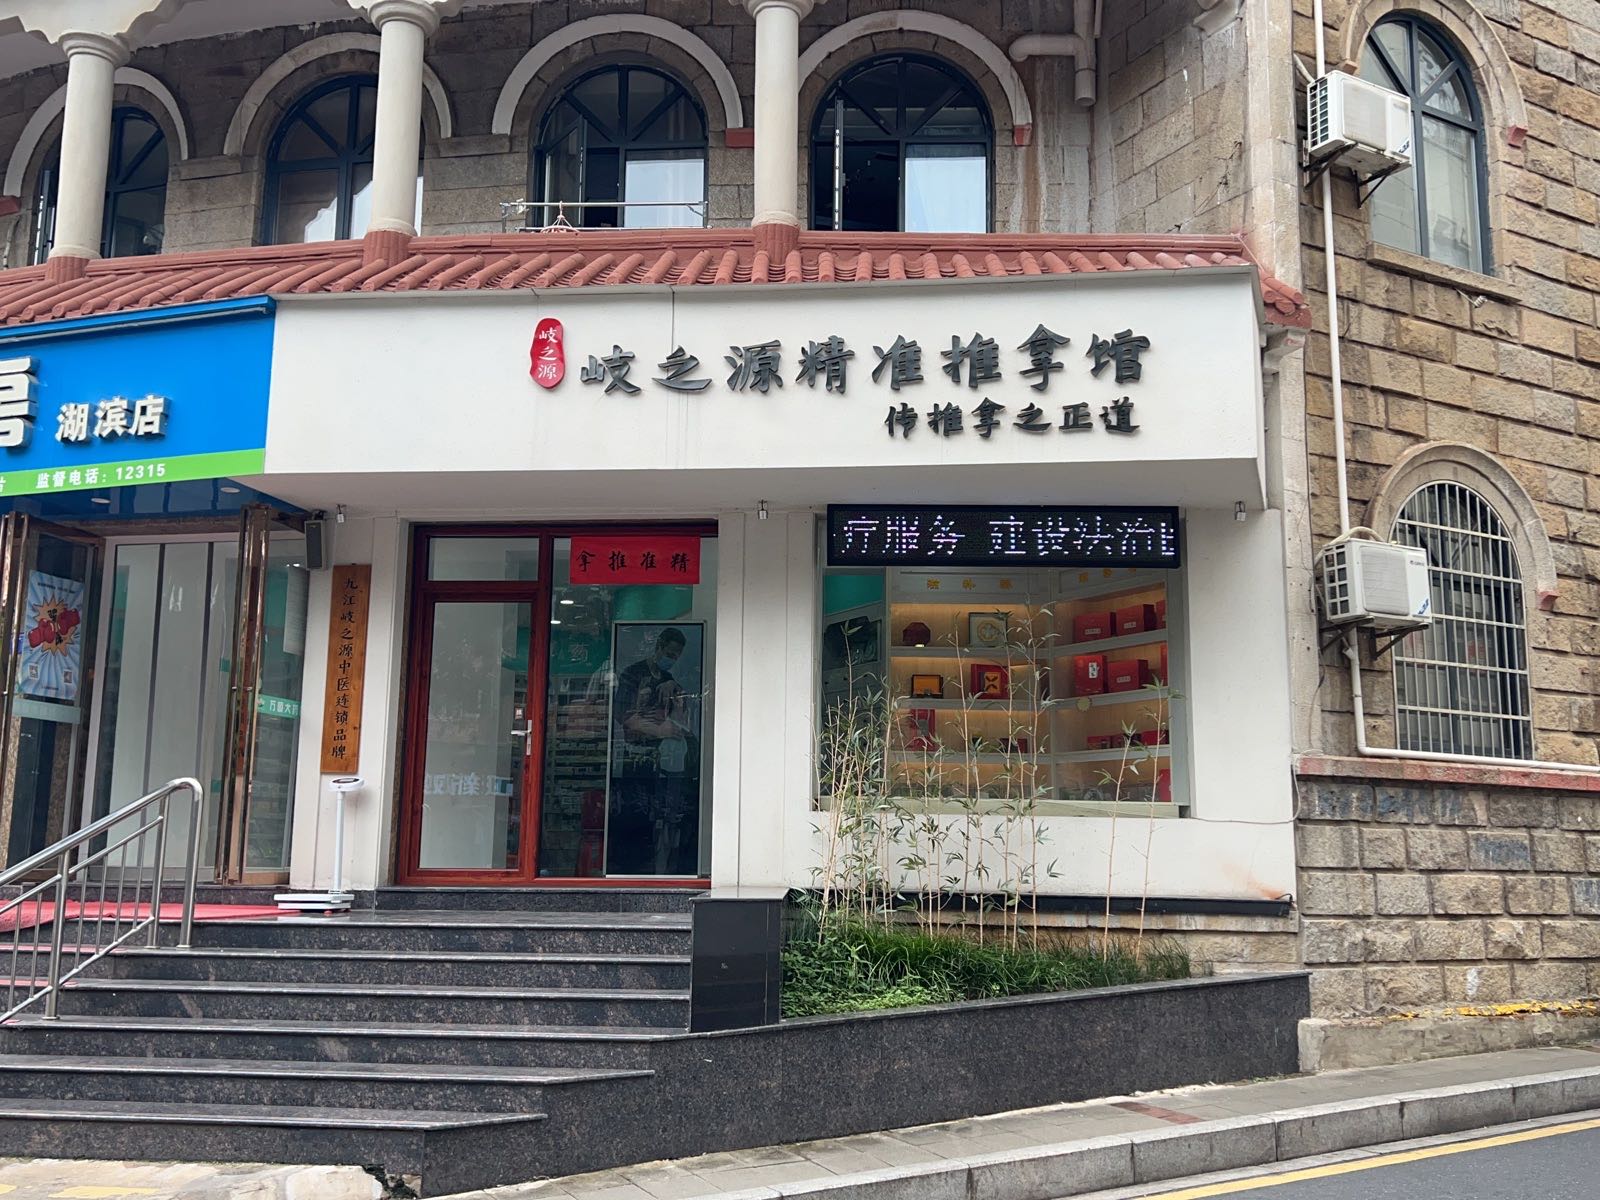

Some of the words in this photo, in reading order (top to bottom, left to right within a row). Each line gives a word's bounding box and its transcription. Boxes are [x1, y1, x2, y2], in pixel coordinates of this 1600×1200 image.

[538, 326, 558, 380] 岐之源
[579, 322, 1151, 396] 岐之源精准推拿馆
[55, 394, 165, 442] 湖滨店
[885, 396, 1141, 439] 传推拿之正道
[331, 577, 358, 760] 九江岐之源中医连锁品牌
